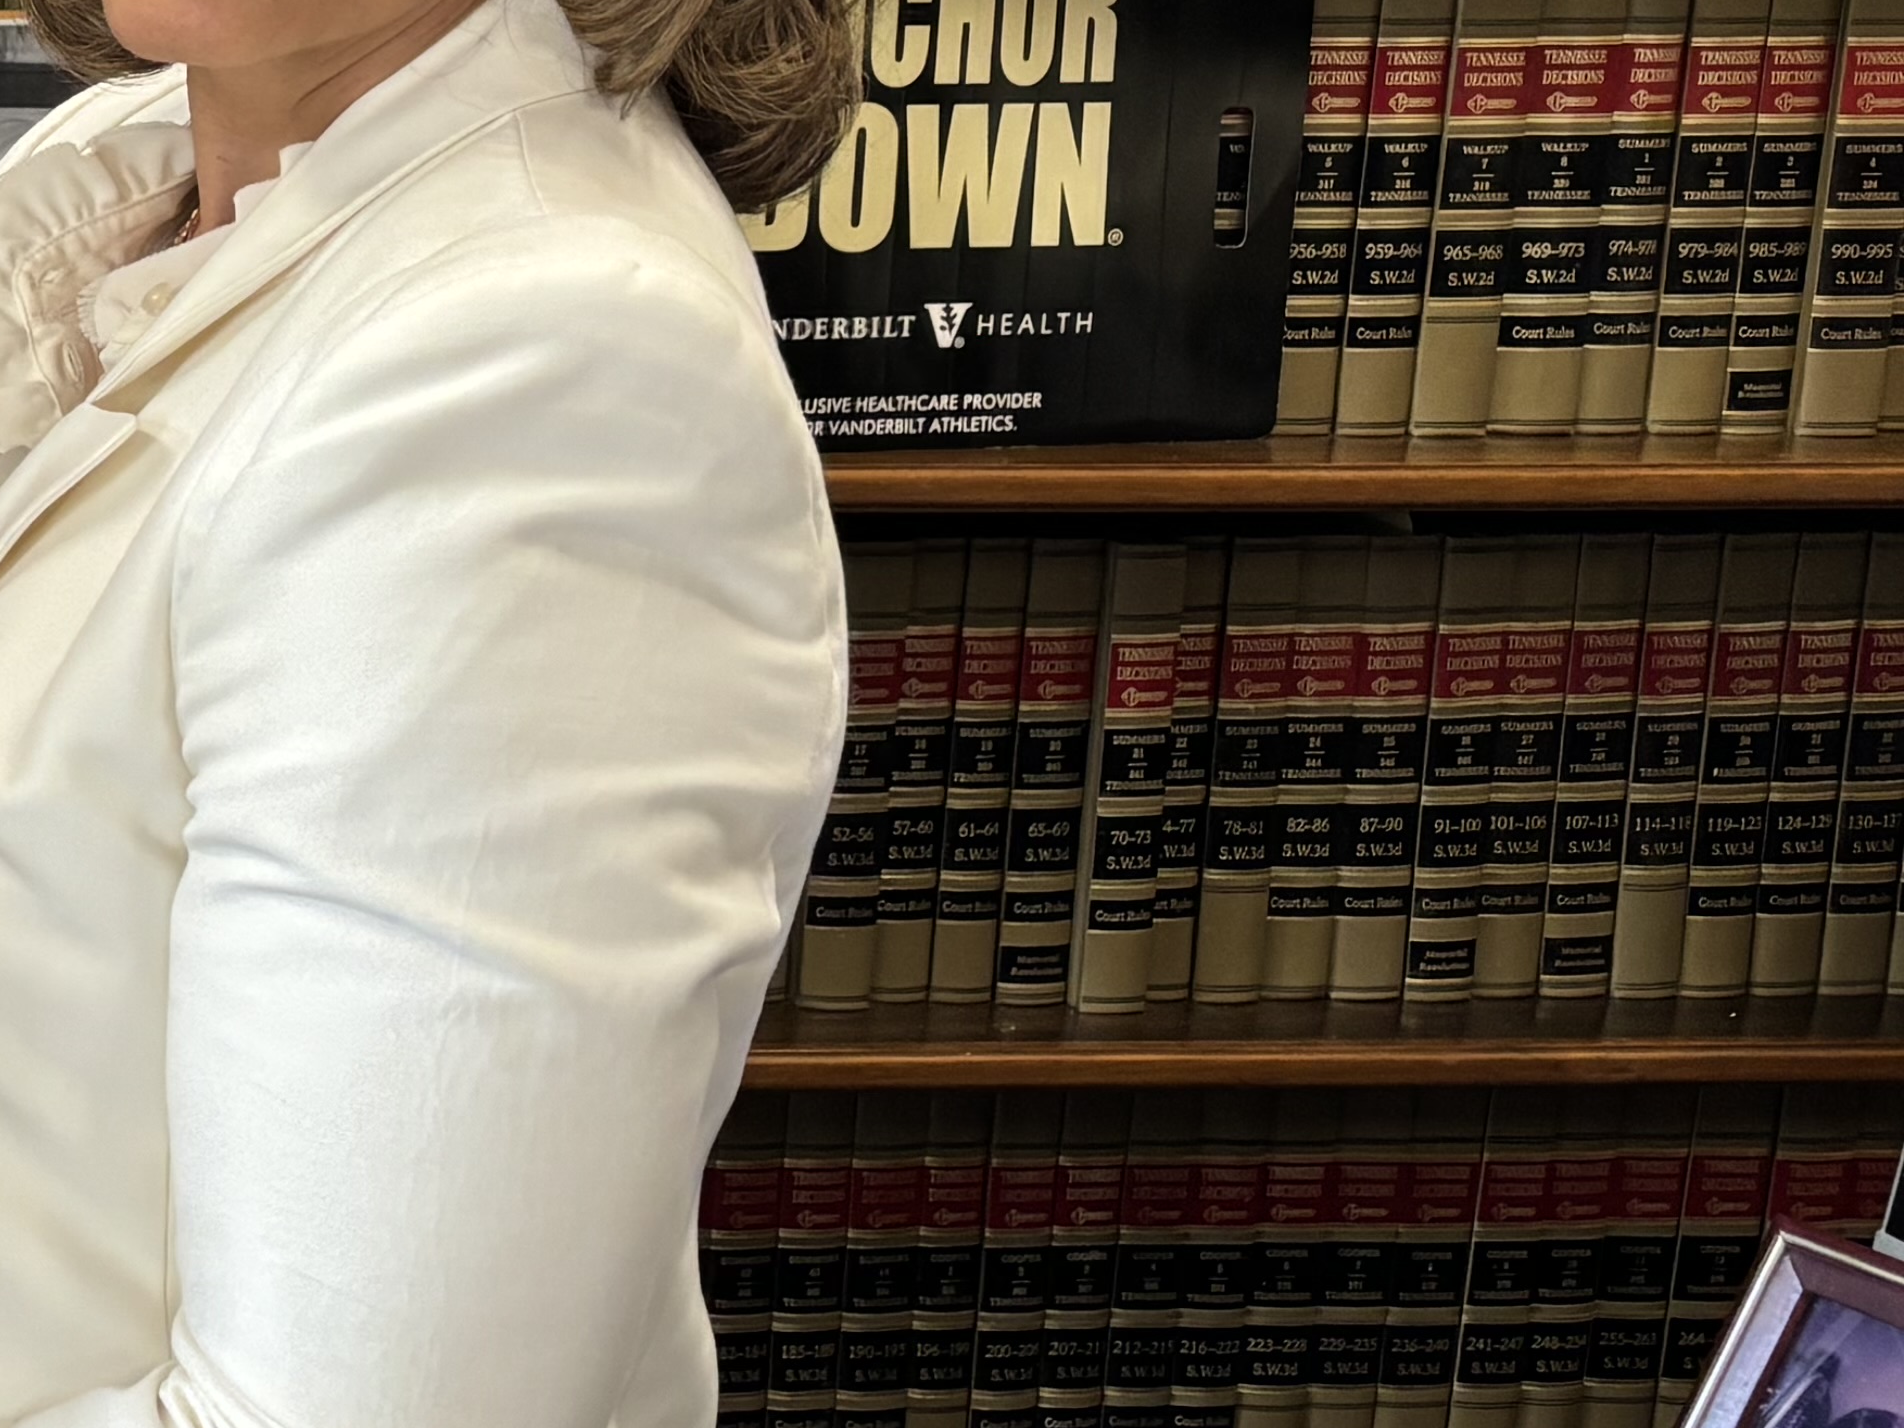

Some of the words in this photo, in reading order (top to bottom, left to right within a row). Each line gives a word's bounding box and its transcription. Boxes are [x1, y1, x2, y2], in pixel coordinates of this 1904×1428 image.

[977, 312, 1094, 336] HEALTH
[855, 394, 958, 412] HEALTHCARE
[963, 392, 1042, 410] PROVIDER
[828, 418, 926, 436] VANDERBILT
[929, 415, 1017, 434] ATHLETICS.
